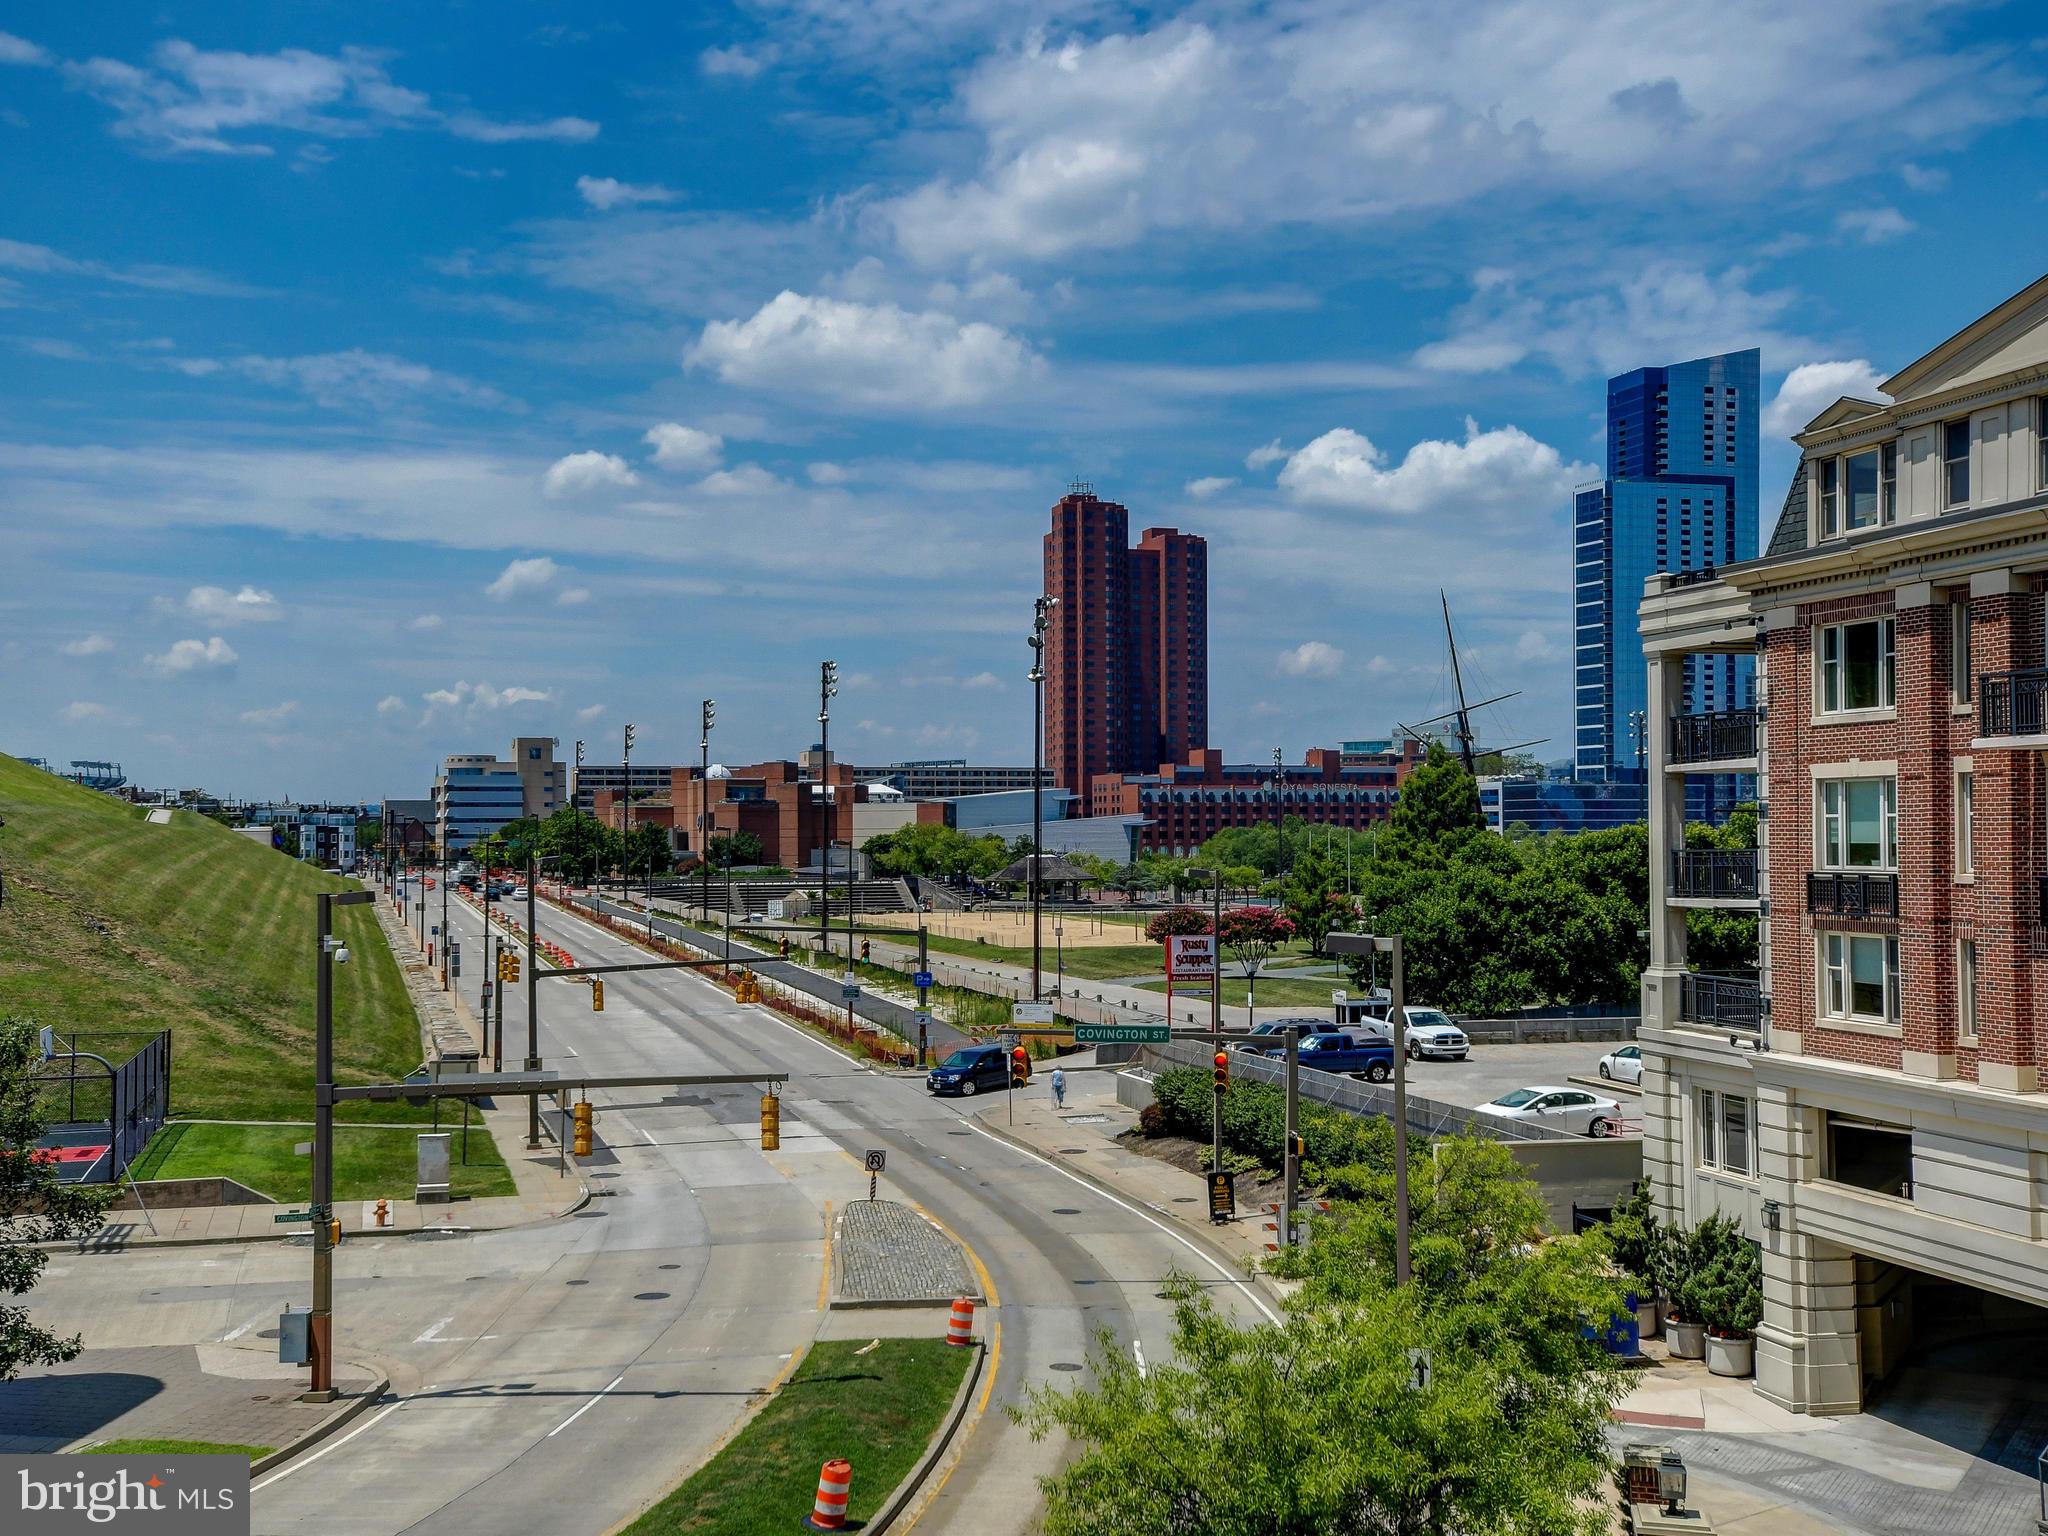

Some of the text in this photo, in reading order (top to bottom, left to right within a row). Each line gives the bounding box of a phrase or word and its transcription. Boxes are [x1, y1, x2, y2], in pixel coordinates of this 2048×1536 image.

[1180, 939, 1209, 952] Rusty
[1175, 954, 1214, 967] Scupper
[1077, 1028, 1167, 1039] COVINGTON ST.
